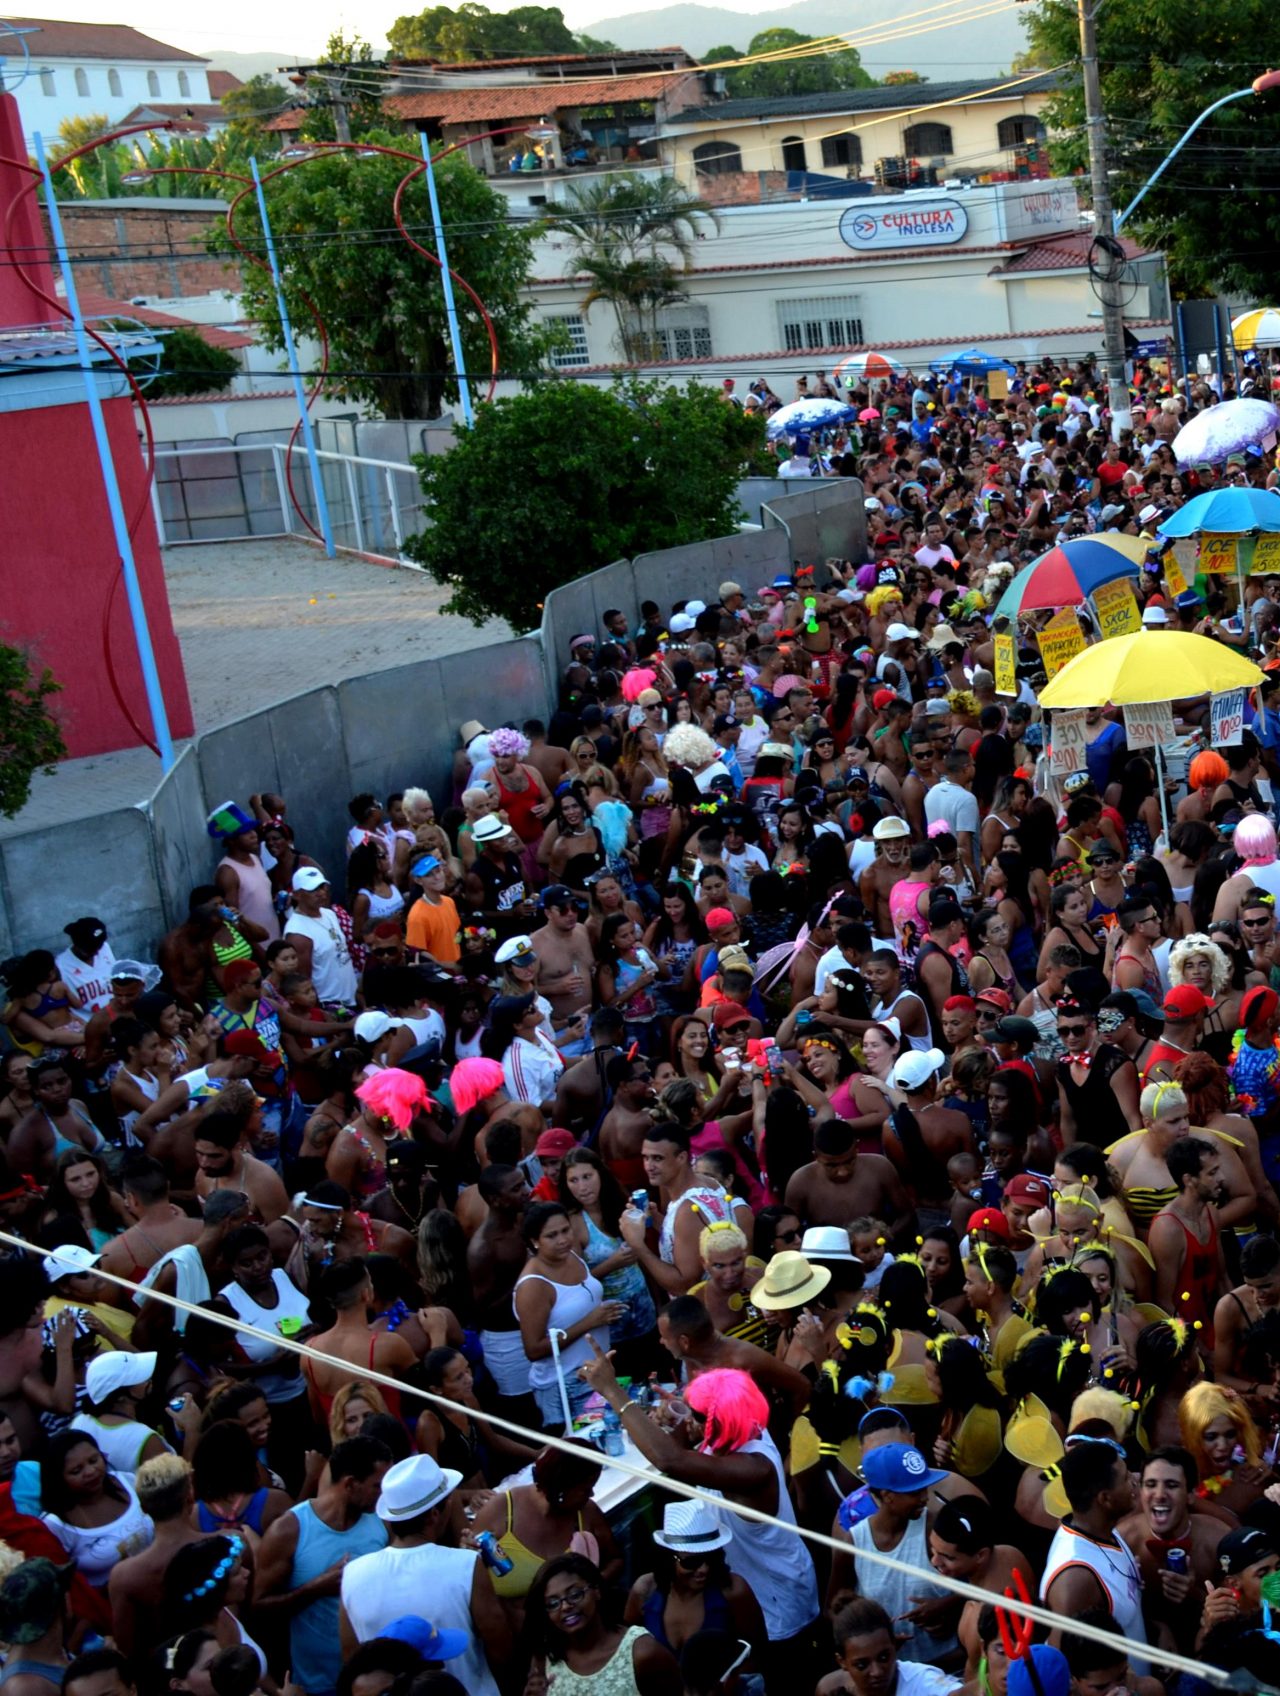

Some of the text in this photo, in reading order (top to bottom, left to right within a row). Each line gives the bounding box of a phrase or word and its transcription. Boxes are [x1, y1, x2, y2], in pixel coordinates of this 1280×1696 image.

[882, 210, 955, 228] CULTURA
[898, 222, 955, 236] INGLESA
[1204, 539, 1235, 553] ICE
[1103, 608, 1133, 628] SKOL
